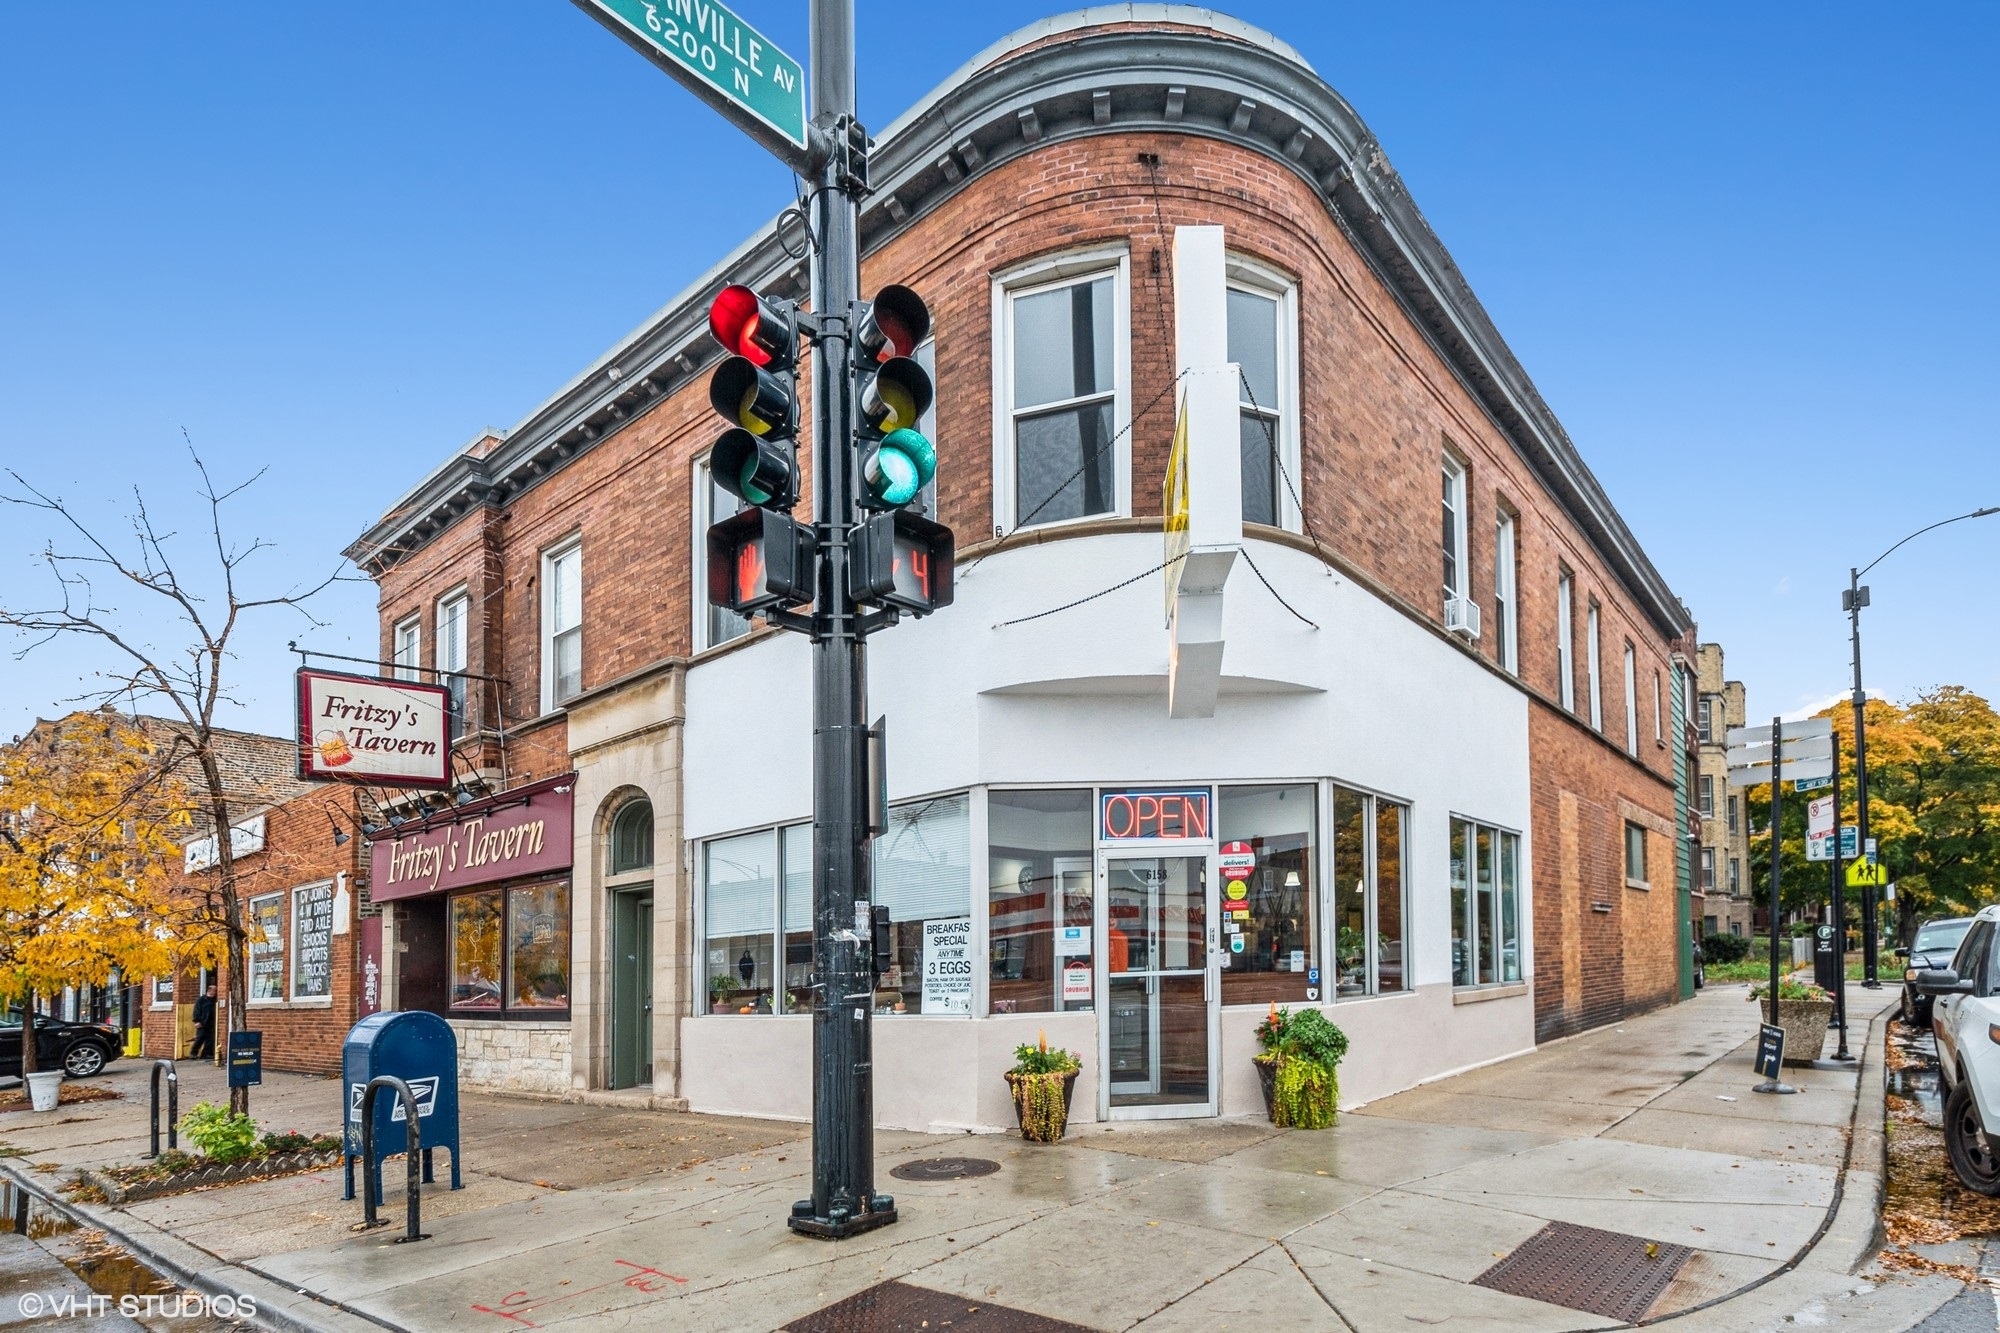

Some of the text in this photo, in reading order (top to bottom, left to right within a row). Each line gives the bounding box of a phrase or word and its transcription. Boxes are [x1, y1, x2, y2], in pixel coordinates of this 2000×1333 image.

[646, 8, 749, 97] 6200 N
[773, 63, 795, 93] AV
[321, 694, 419, 731] Fritzy's
[348, 726, 437, 757] Tavern
[1106, 795, 1207, 838] OPEN
[387, 818, 545, 891] Fritzy's Tavern
[1146, 869, 1168, 880] 6158
[310, 885, 332, 901] JOINTS
[313, 899, 332, 916] DRIVE
[300, 915, 332, 932] FWD AXLE
[926, 922, 970, 935] BREAKFAS
[303, 931, 328, 947] SHOCKS
[933, 935, 968, 946] SPECIAL
[301, 947, 328, 962] IMPORTS
[937, 949, 965, 958] ANYTIME
[303, 962, 328, 976] TRUCKS
[929, 961, 971, 975] 3 EGGS
[306, 978, 323, 992] VANS
